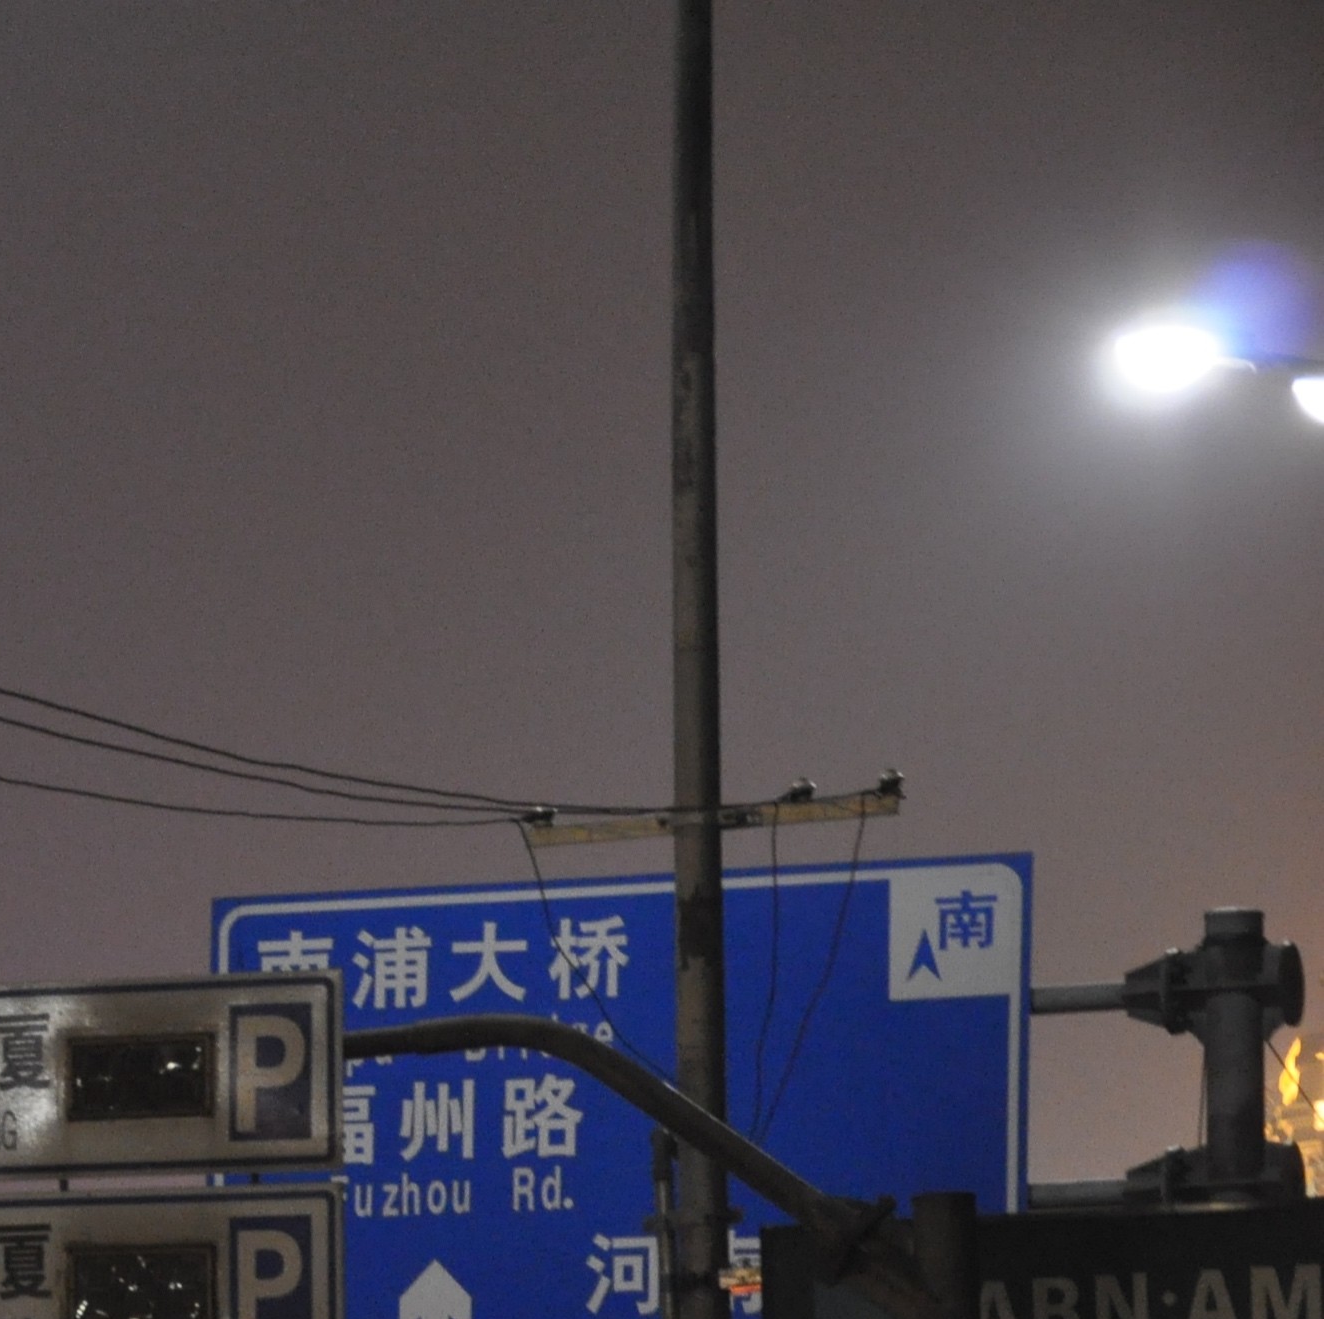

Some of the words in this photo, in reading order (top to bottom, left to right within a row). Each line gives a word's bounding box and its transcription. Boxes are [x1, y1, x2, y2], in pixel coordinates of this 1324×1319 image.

[936, 889, 997, 950] 南
[257, 915, 629, 1009] 南浦大桥
[234, 1015, 306, 1133] P
[512, 1165, 574, 1212] Rd.
